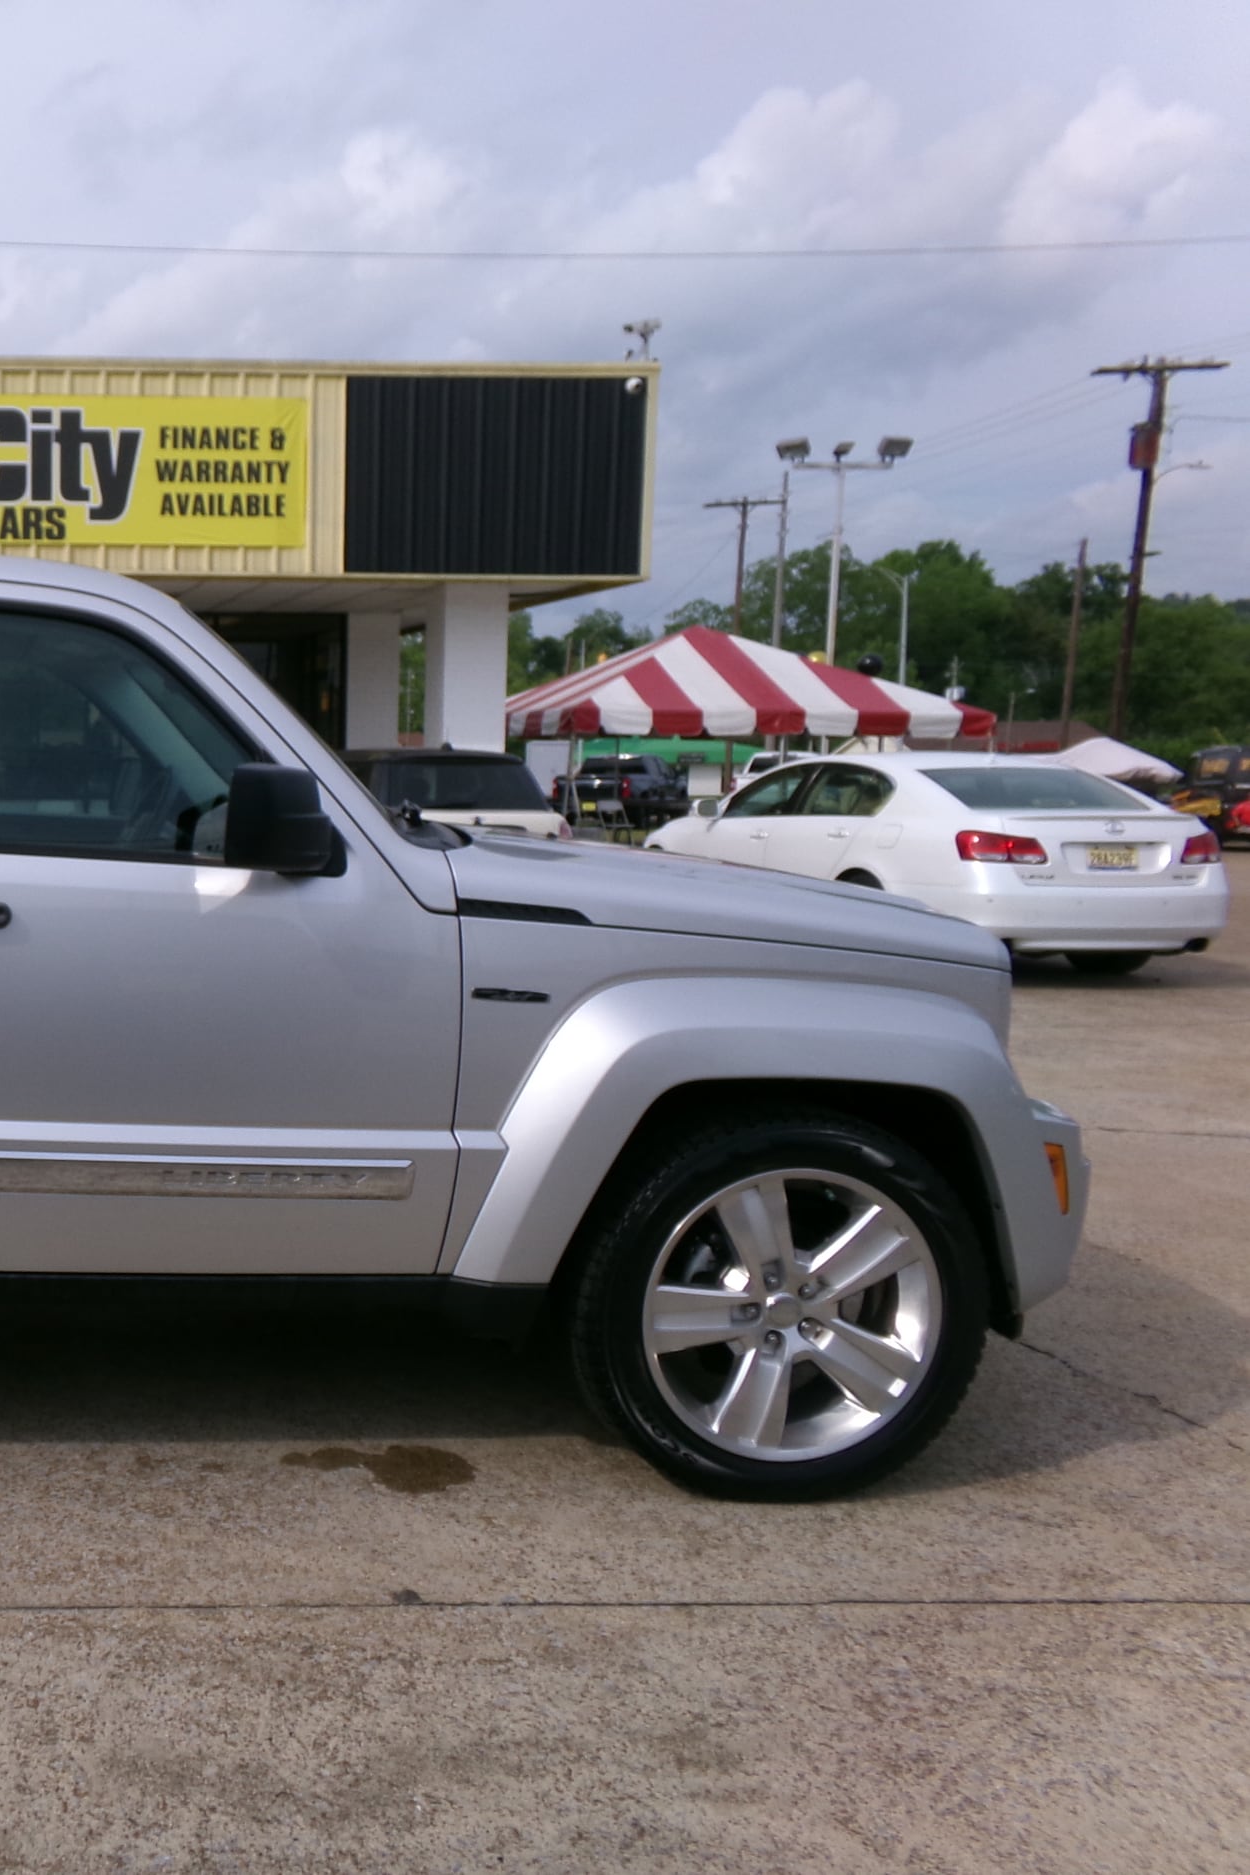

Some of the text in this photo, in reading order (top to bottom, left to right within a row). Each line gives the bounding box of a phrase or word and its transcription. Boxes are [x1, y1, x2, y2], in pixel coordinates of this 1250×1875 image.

[159, 425, 286, 451] FINANCE &
[154, 459, 290, 484] WARRANTY
[160, 493, 286, 517] AVAILABLE
